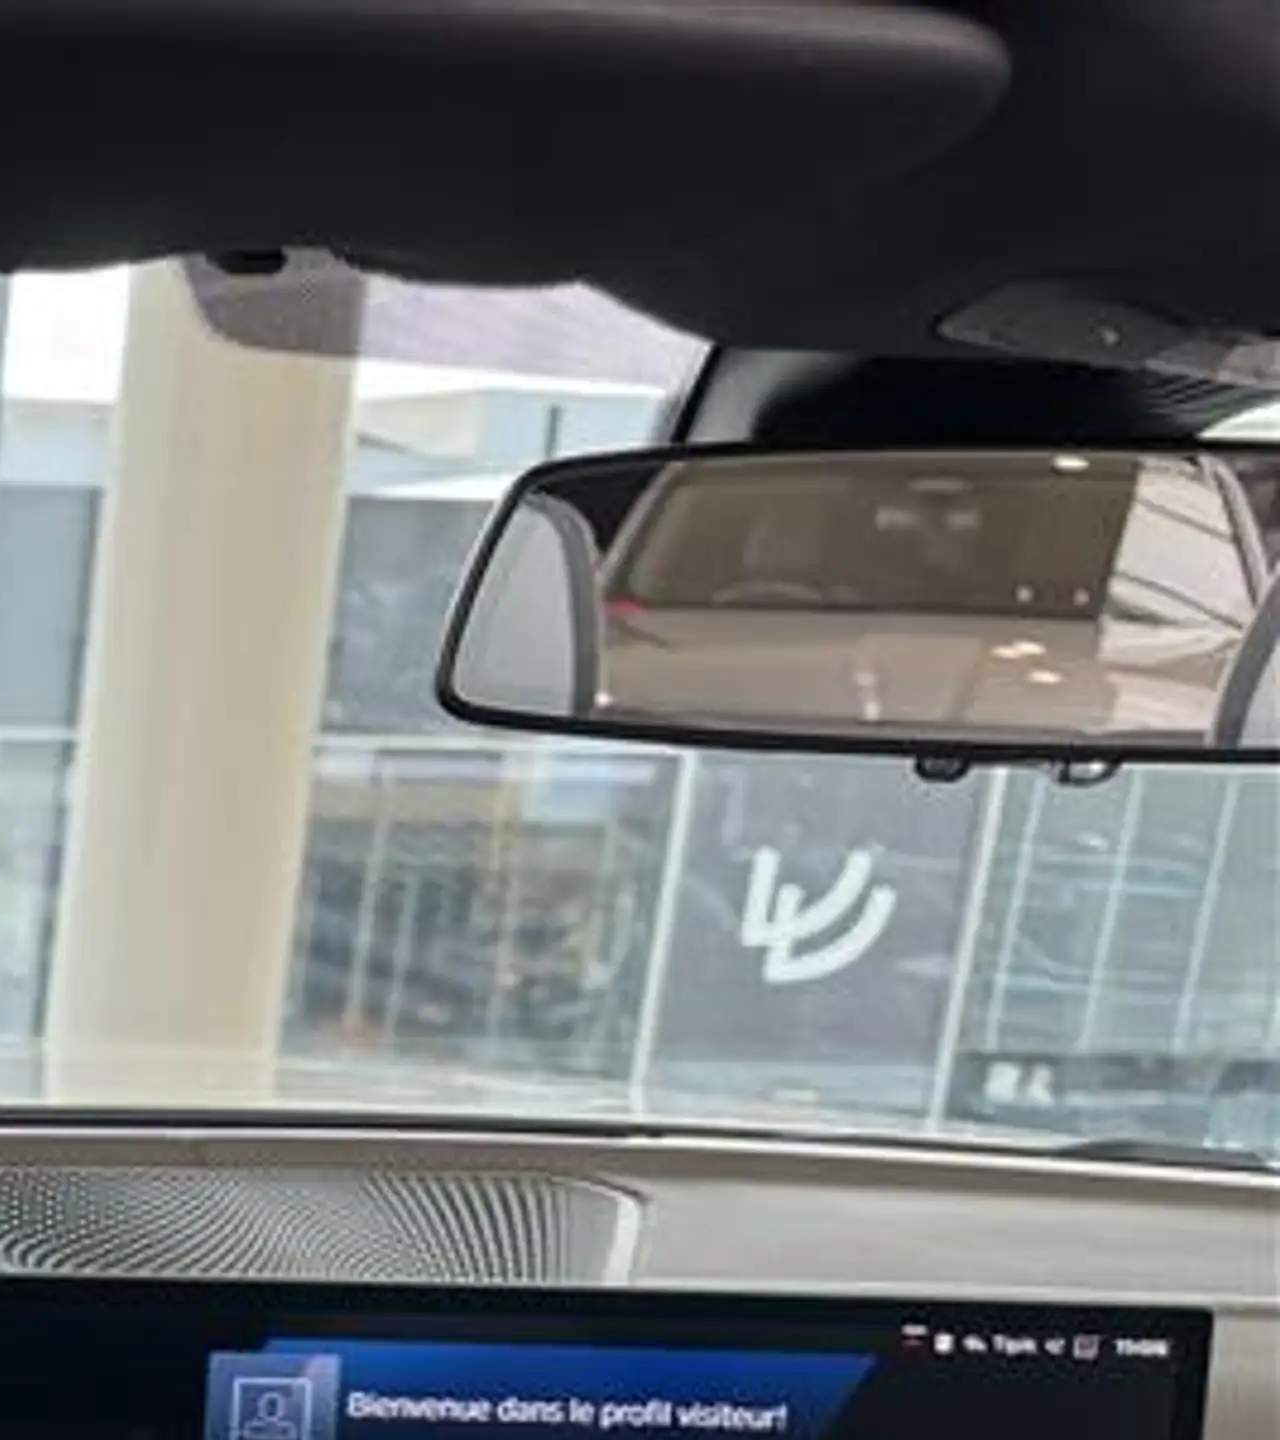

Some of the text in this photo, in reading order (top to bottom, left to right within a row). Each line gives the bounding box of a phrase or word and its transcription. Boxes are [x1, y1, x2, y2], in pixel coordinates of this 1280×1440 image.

[346, 1391, 788, 1431] Bienvenue dans le profil visiteur!
